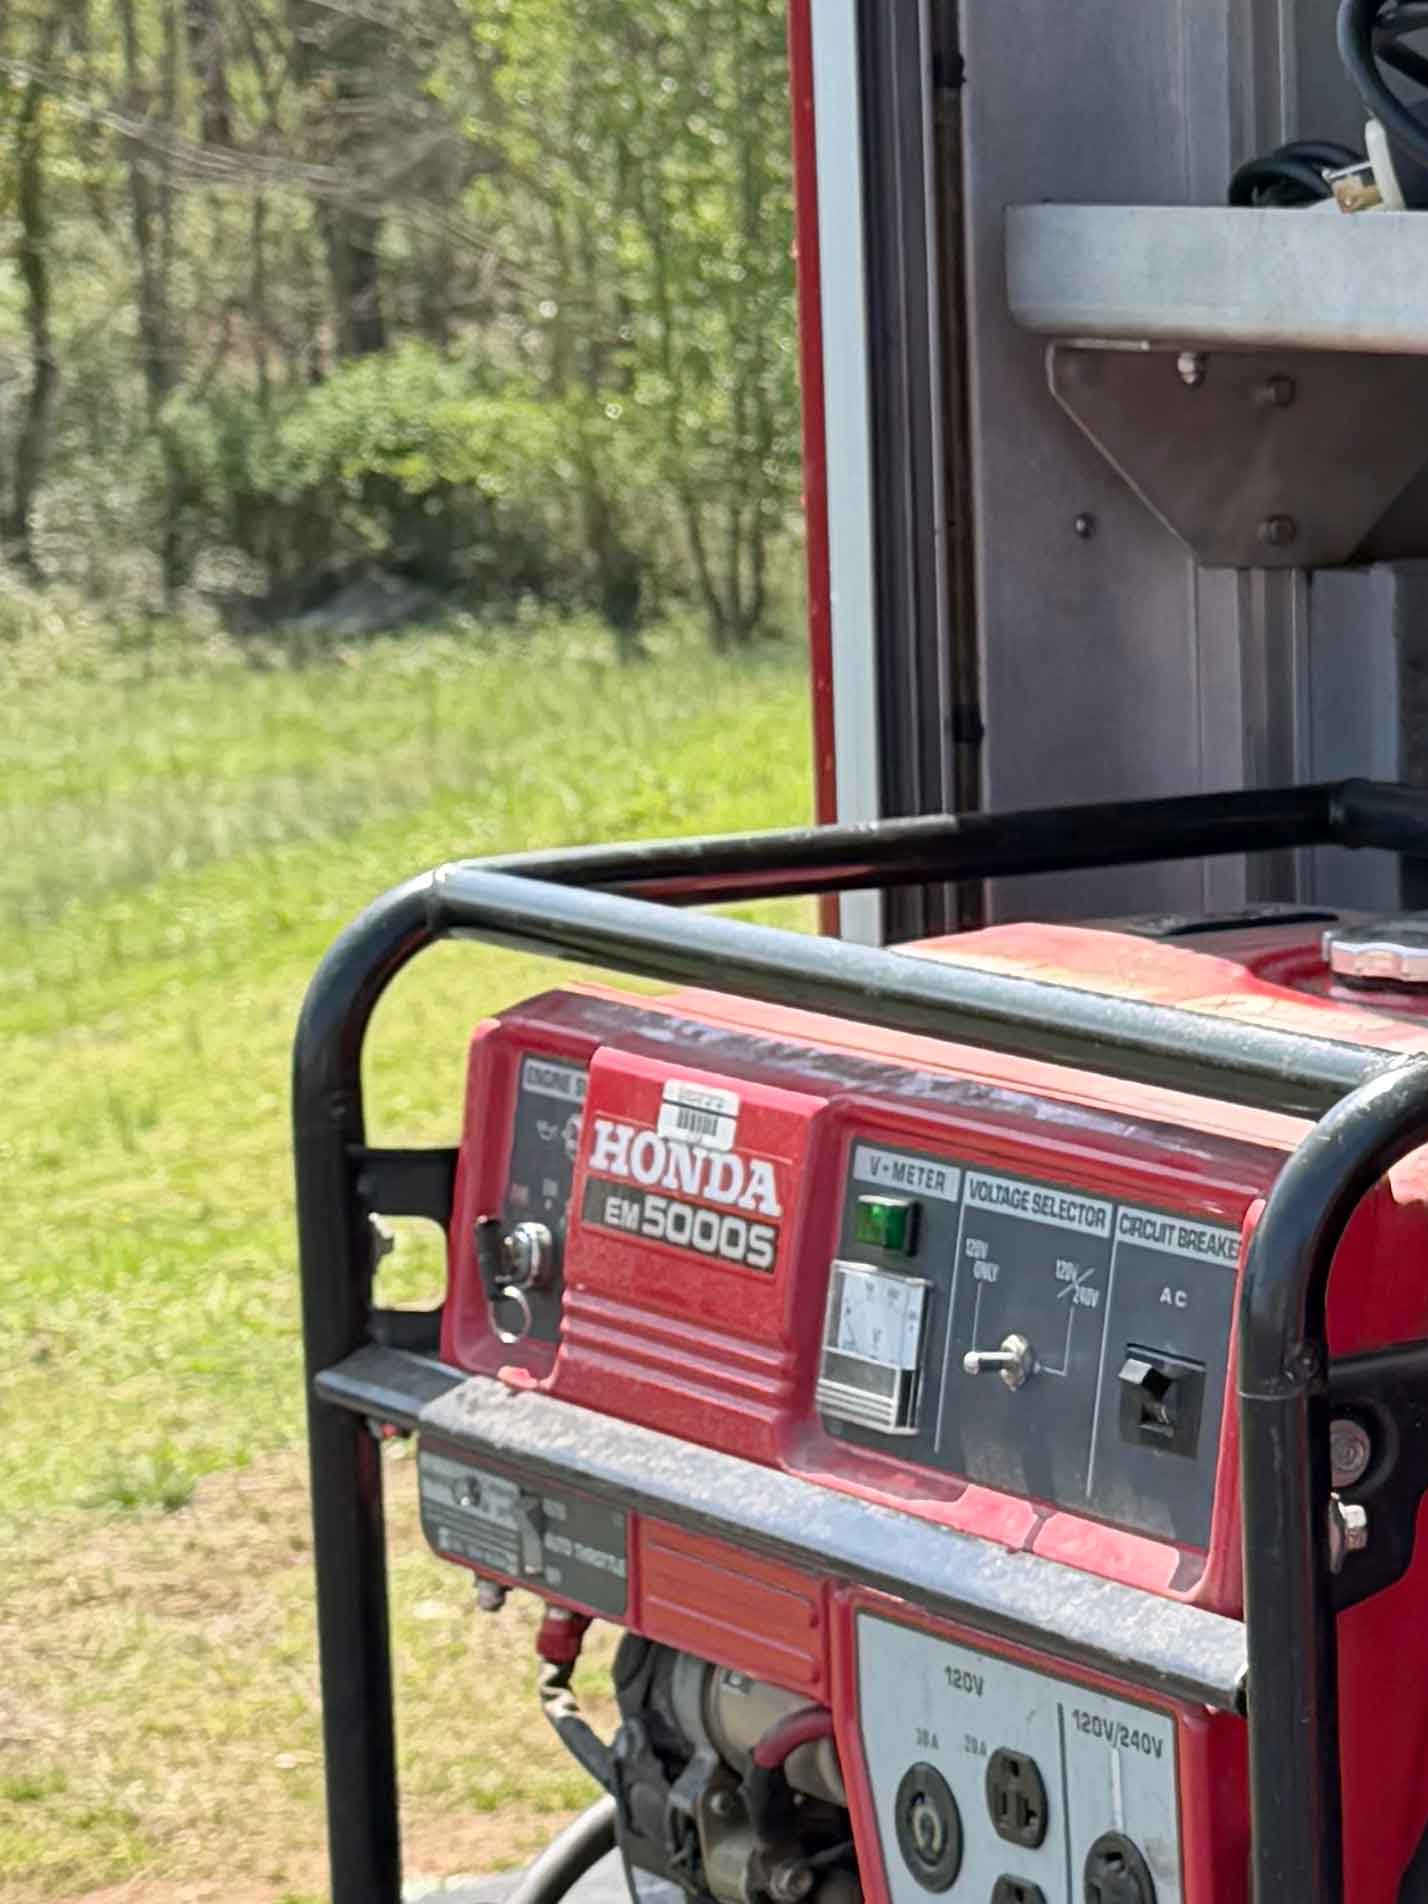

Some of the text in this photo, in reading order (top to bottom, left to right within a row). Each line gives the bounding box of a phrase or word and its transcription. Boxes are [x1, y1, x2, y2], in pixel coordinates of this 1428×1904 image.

[588, 1120, 782, 1217] HONDA
[968, 1179, 1108, 1230] VOLTAGE SELECTOR
[603, 1194, 775, 1269] EM5000S
[1118, 1211, 1241, 1261] CIRCUIT BREAKE
[945, 1665, 985, 1699] 120V
[1072, 1709, 1164, 1762] 120V/240V
